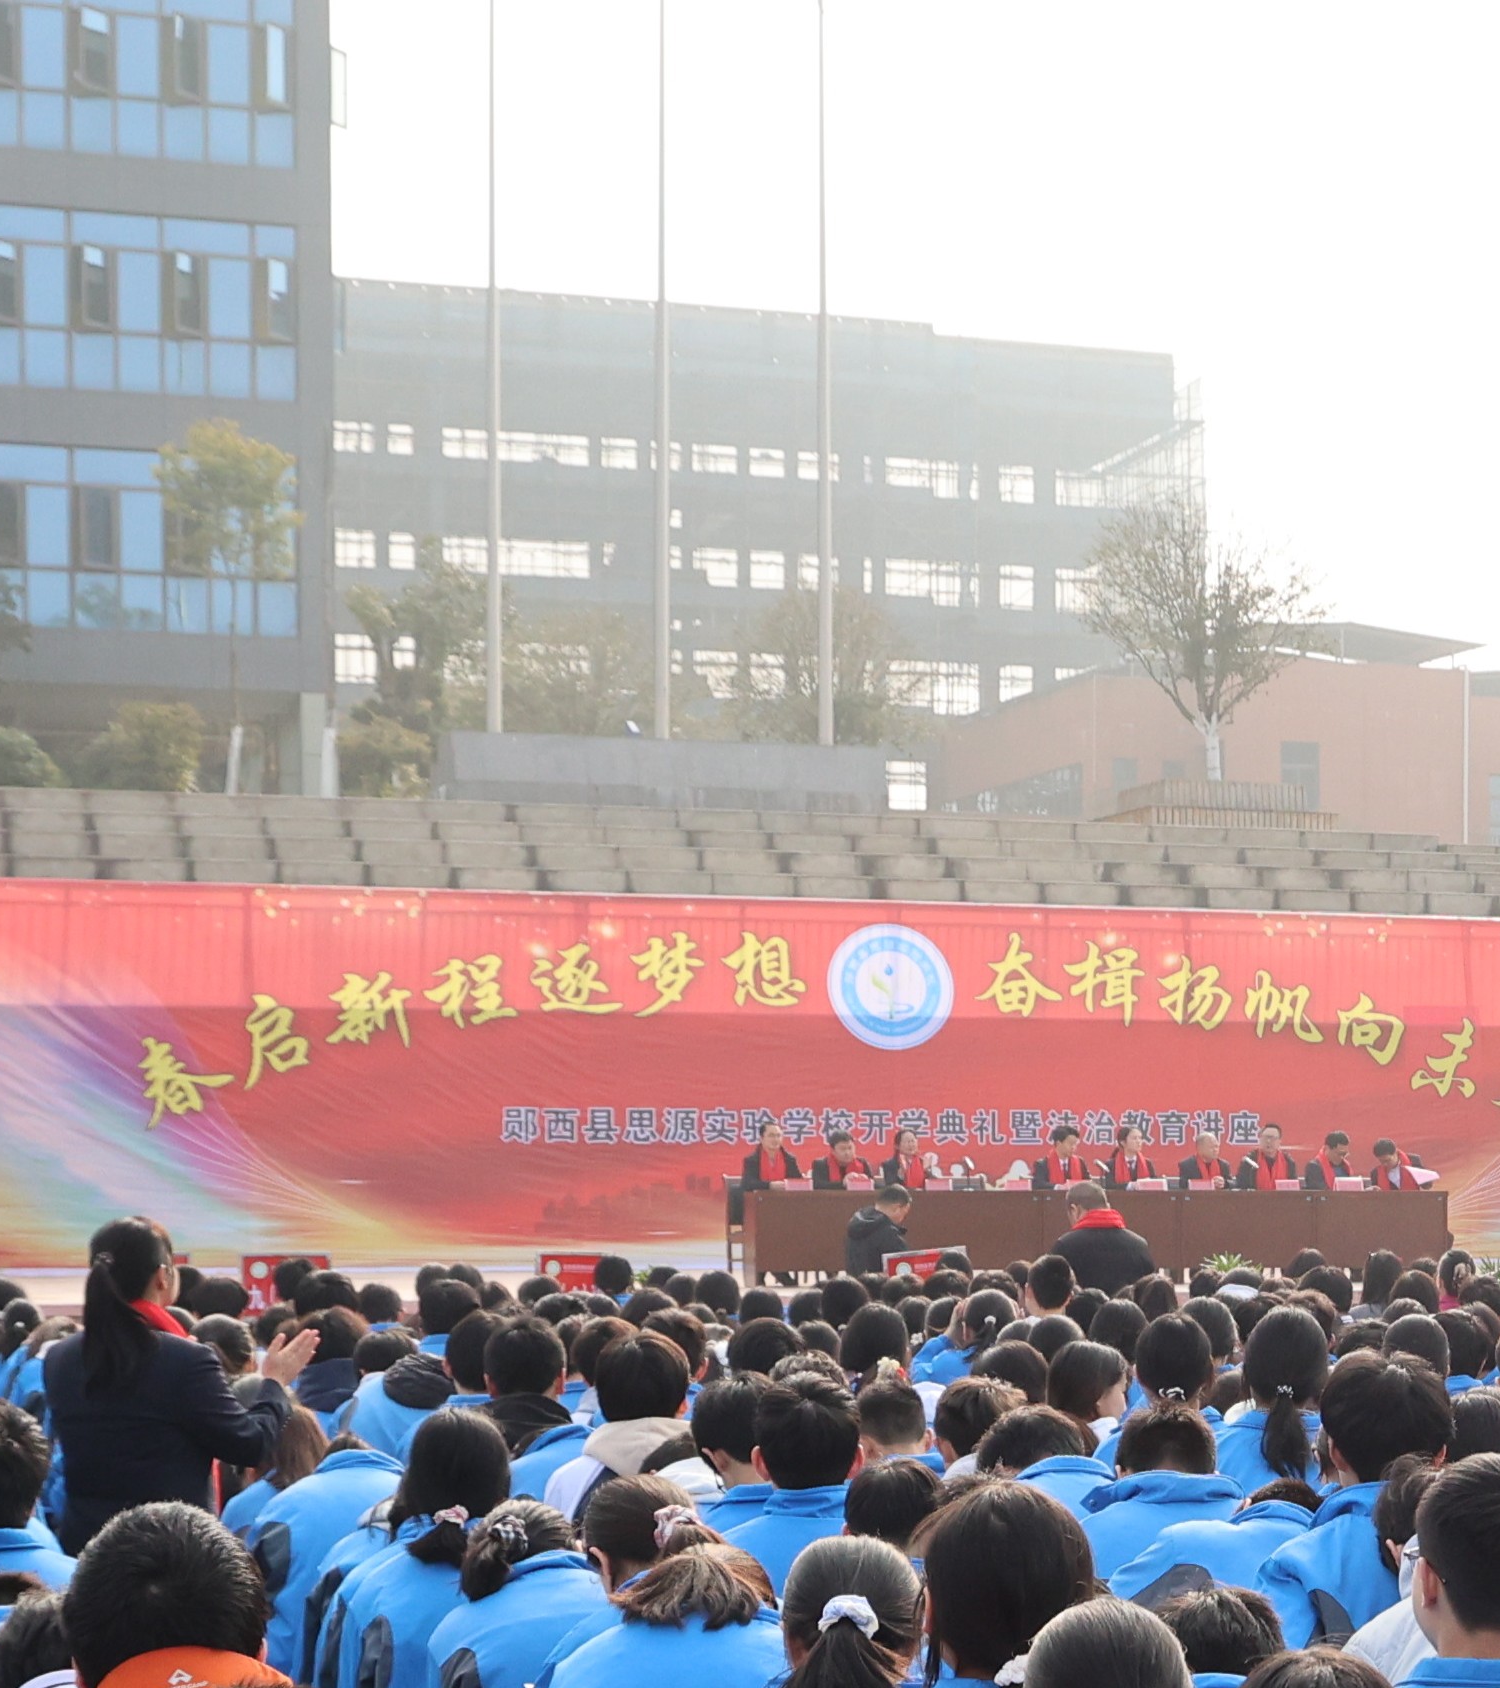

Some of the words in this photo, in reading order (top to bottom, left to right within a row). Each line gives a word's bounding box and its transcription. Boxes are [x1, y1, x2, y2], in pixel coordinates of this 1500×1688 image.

[137, 931, 807, 1130] 春启新程逐梦想
